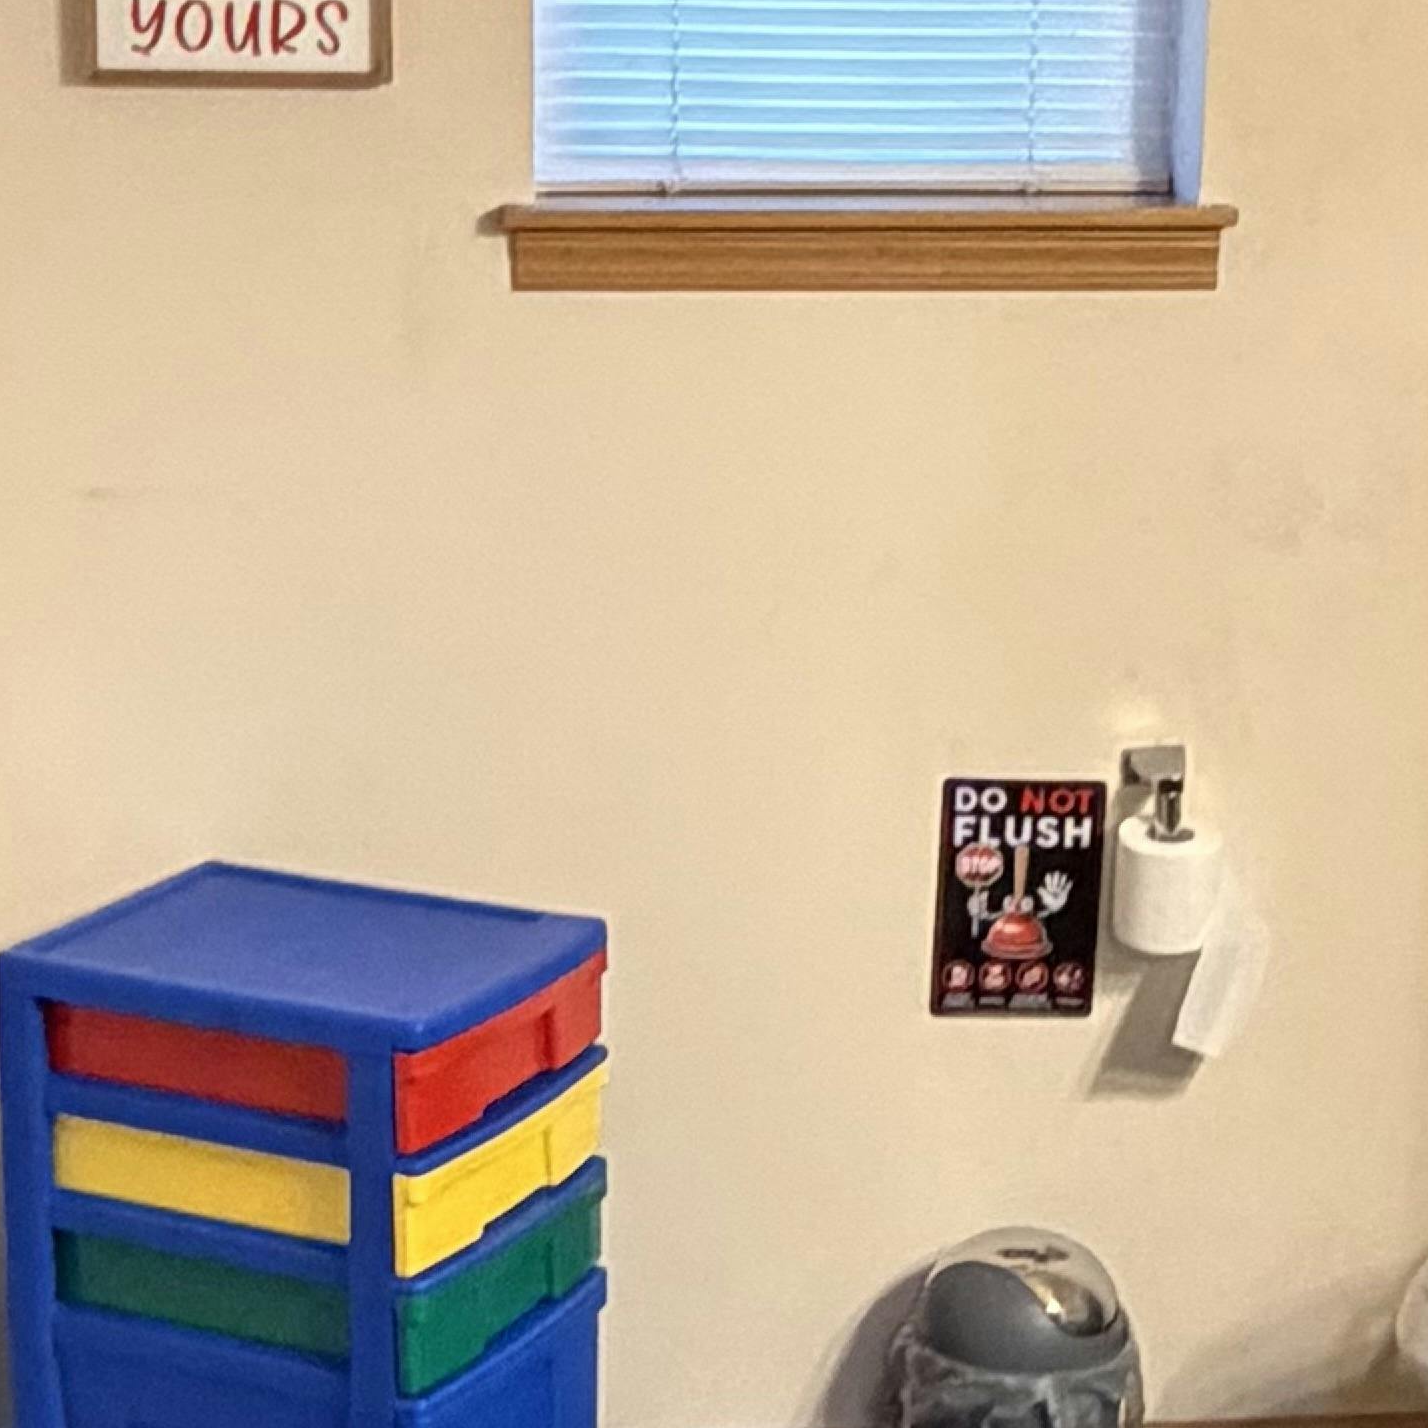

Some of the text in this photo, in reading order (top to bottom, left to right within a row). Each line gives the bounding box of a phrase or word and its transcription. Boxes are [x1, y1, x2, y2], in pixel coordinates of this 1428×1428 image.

[954, 786, 1094, 815] DO NOT
[952, 815, 1093, 849] FLUSH
